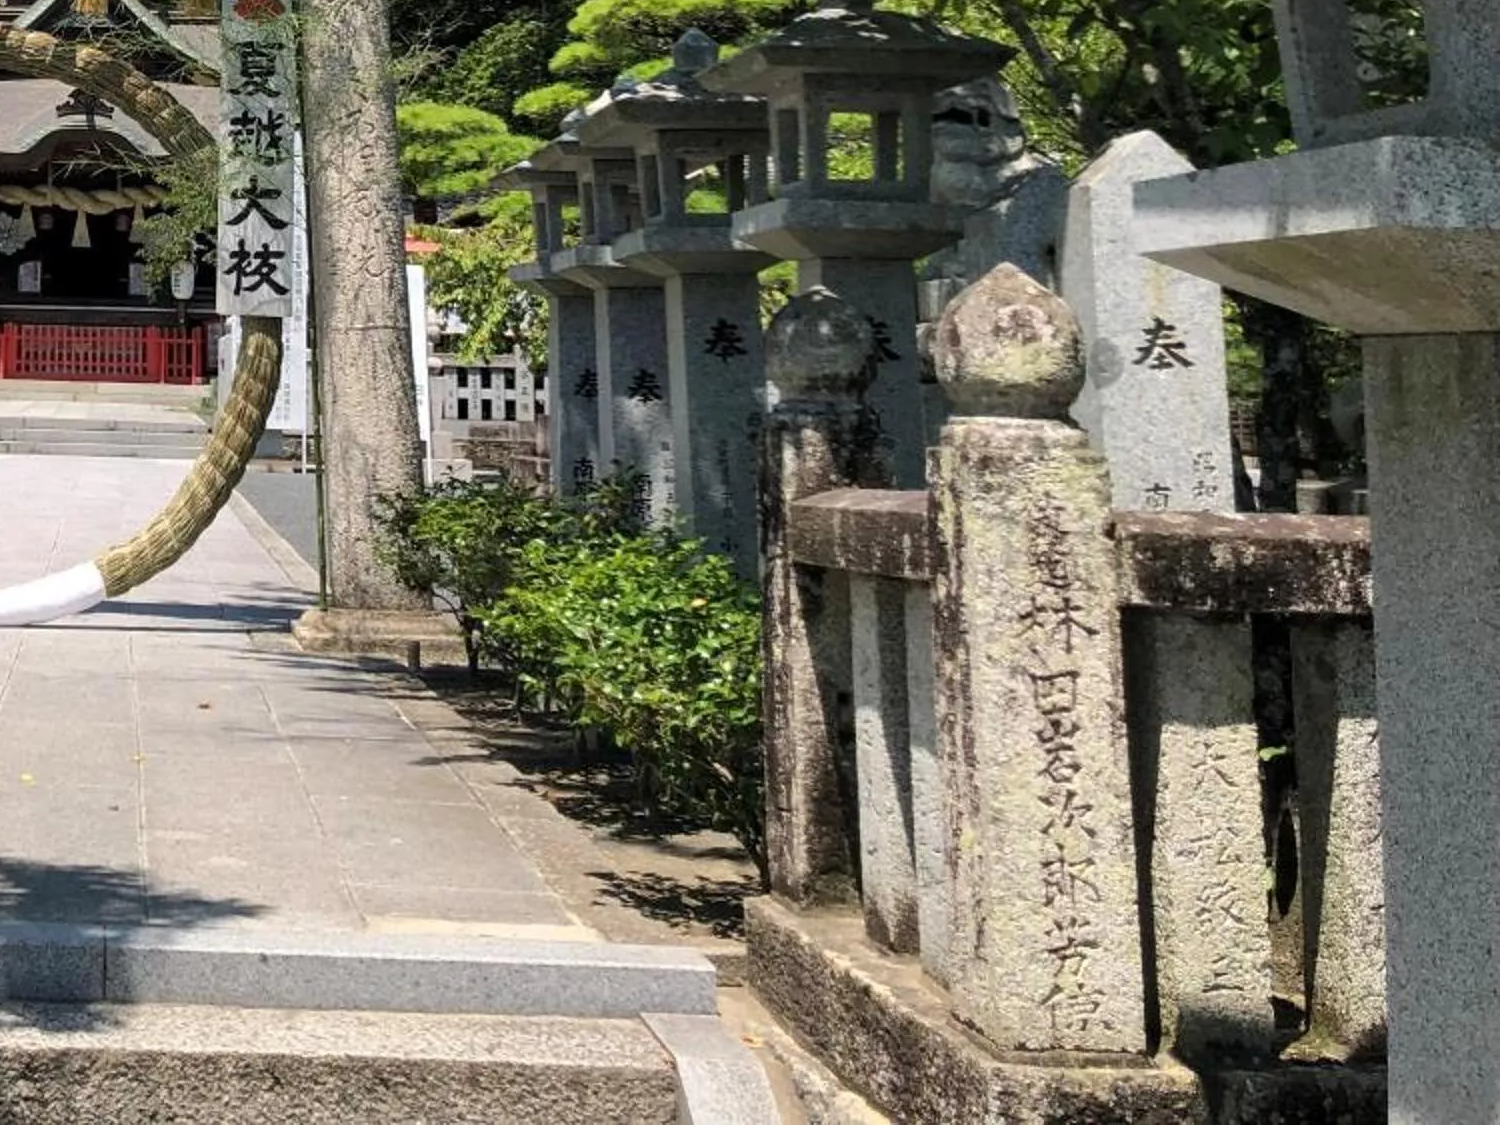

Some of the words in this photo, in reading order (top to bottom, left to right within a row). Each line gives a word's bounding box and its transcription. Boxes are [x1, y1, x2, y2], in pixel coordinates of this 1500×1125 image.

[222, 40, 290, 298] 夏越大祓
[705, 316, 747, 367] 奉
[1129, 314, 1198, 371] 奉
[624, 366, 665, 404] 奉
